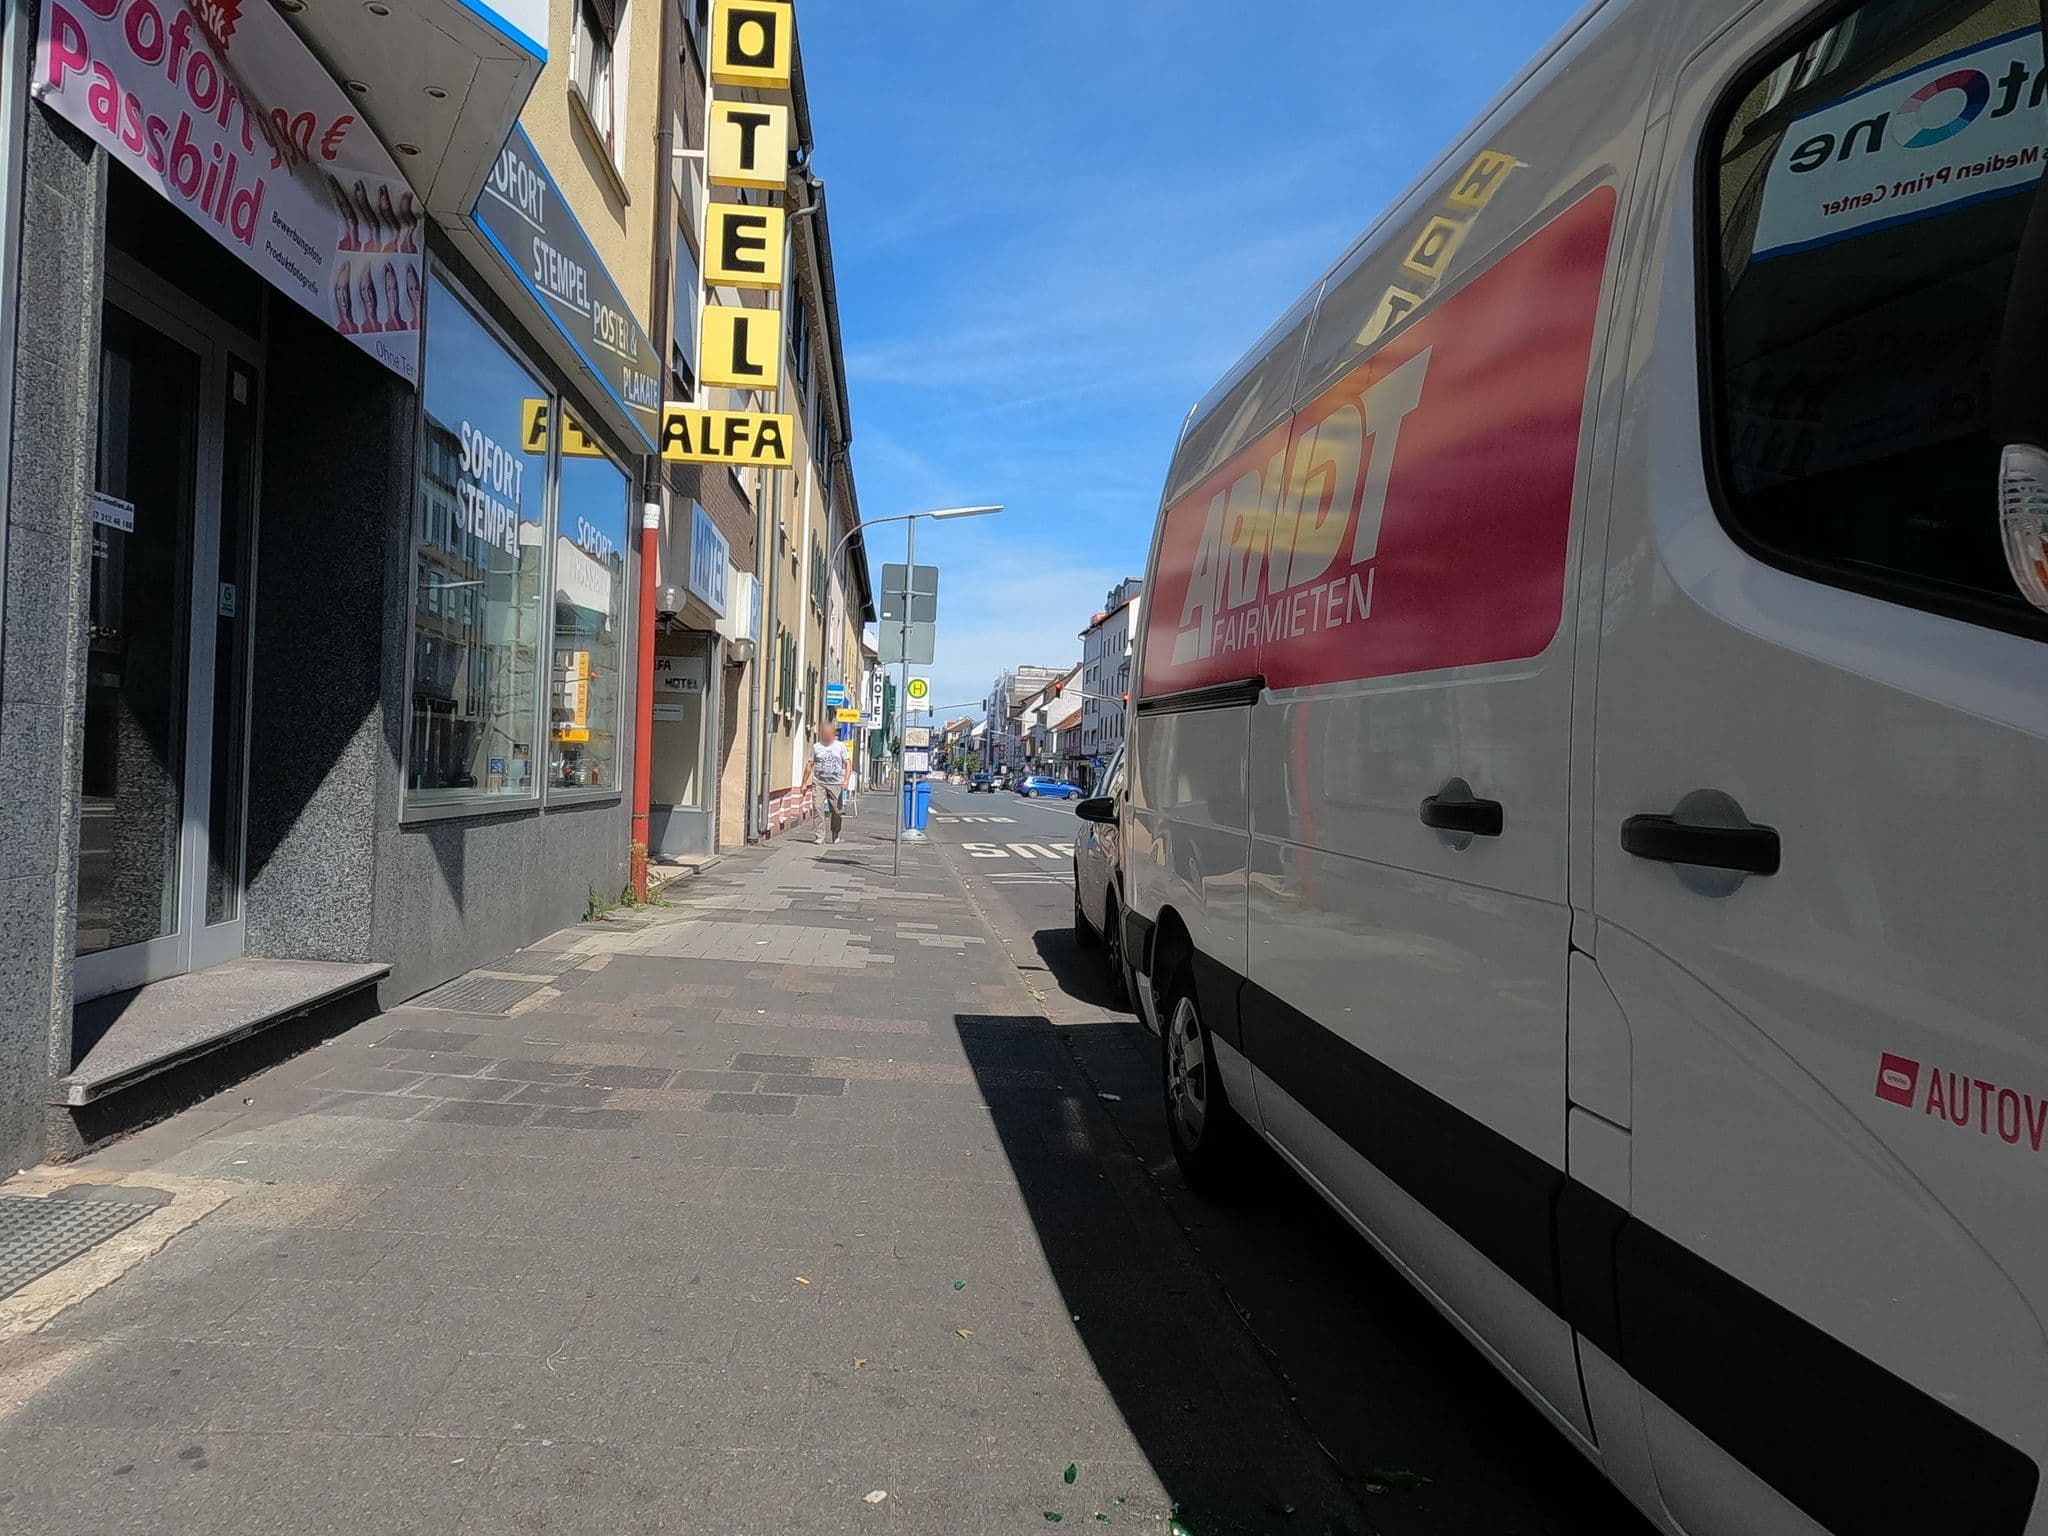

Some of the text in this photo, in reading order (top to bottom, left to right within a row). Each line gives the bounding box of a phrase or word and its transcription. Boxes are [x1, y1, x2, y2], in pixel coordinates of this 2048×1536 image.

[48, 2, 266, 250] Passbild
[272, 210, 323, 266] Bewerbungsfoto
[533, 235, 591, 310] STEMPEL
[376, 340, 400, 369] Ohne
[593, 300, 631, 351] POSTER
[623, 365, 658, 409] PLAKATE
[459, 420, 524, 504] SOFORT
[661, 412, 786, 460] ALFA
[456, 478, 520, 559] STEMPEL
[1170, 344, 1433, 667] ARNDT
[577, 516, 612, 566] SOFORT
[1211, 567, 1376, 657] FAIRMIETEN
[665, 678, 698, 690] HOTEL
[1925, 1067, 2048, 1152] AUTOV
